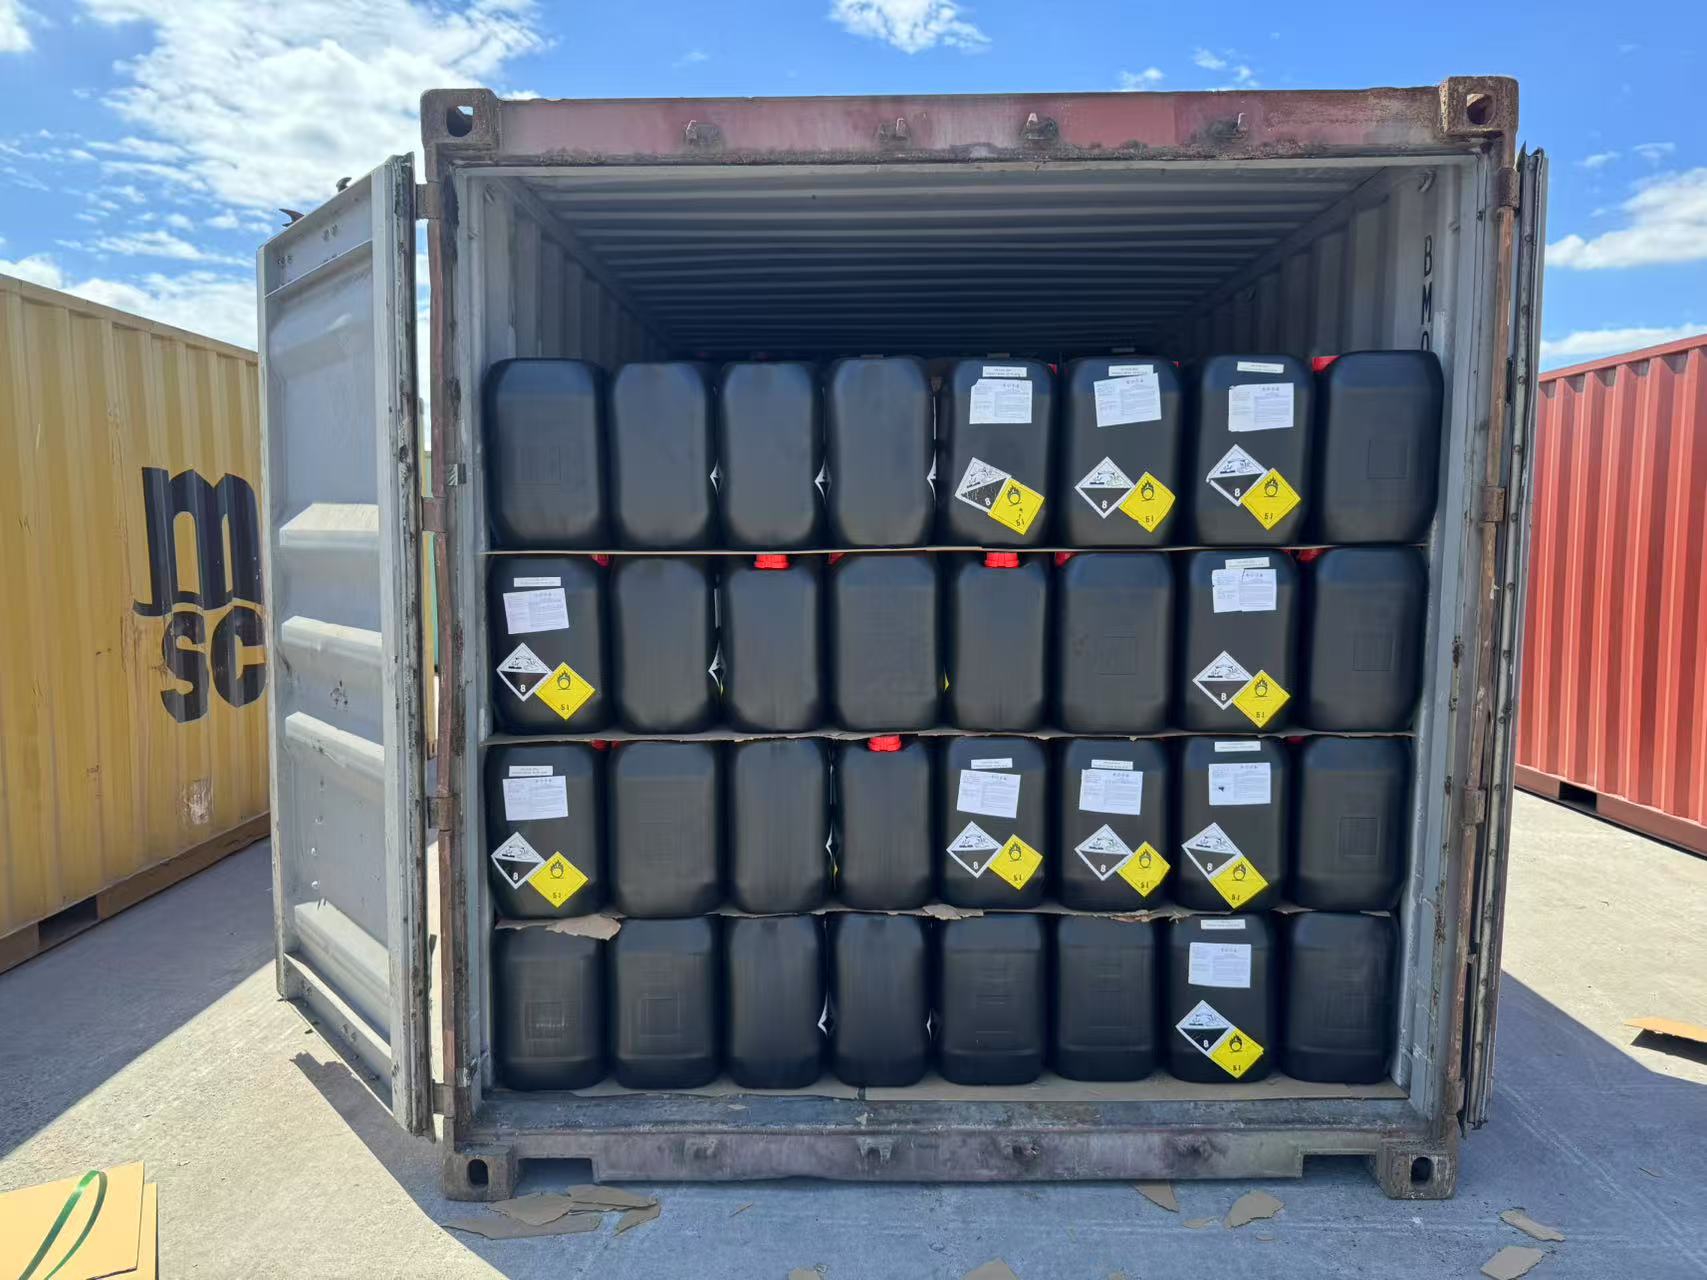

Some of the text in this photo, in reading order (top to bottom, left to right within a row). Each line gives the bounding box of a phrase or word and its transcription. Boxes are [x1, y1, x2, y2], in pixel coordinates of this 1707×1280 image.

[1234, 487, 1241, 497] 8
[985, 497, 991, 506] 8
[1101, 500, 1108, 509] 8
[520, 684, 526, 693] 8
[1221, 692, 1227, 701] 8
[973, 861, 979, 870] 8
[1100, 864, 1106, 873] 8
[1207, 862, 1213, 871] 8
[513, 872, 519, 881] 8
[1203, 1039, 1209, 1048] 8
